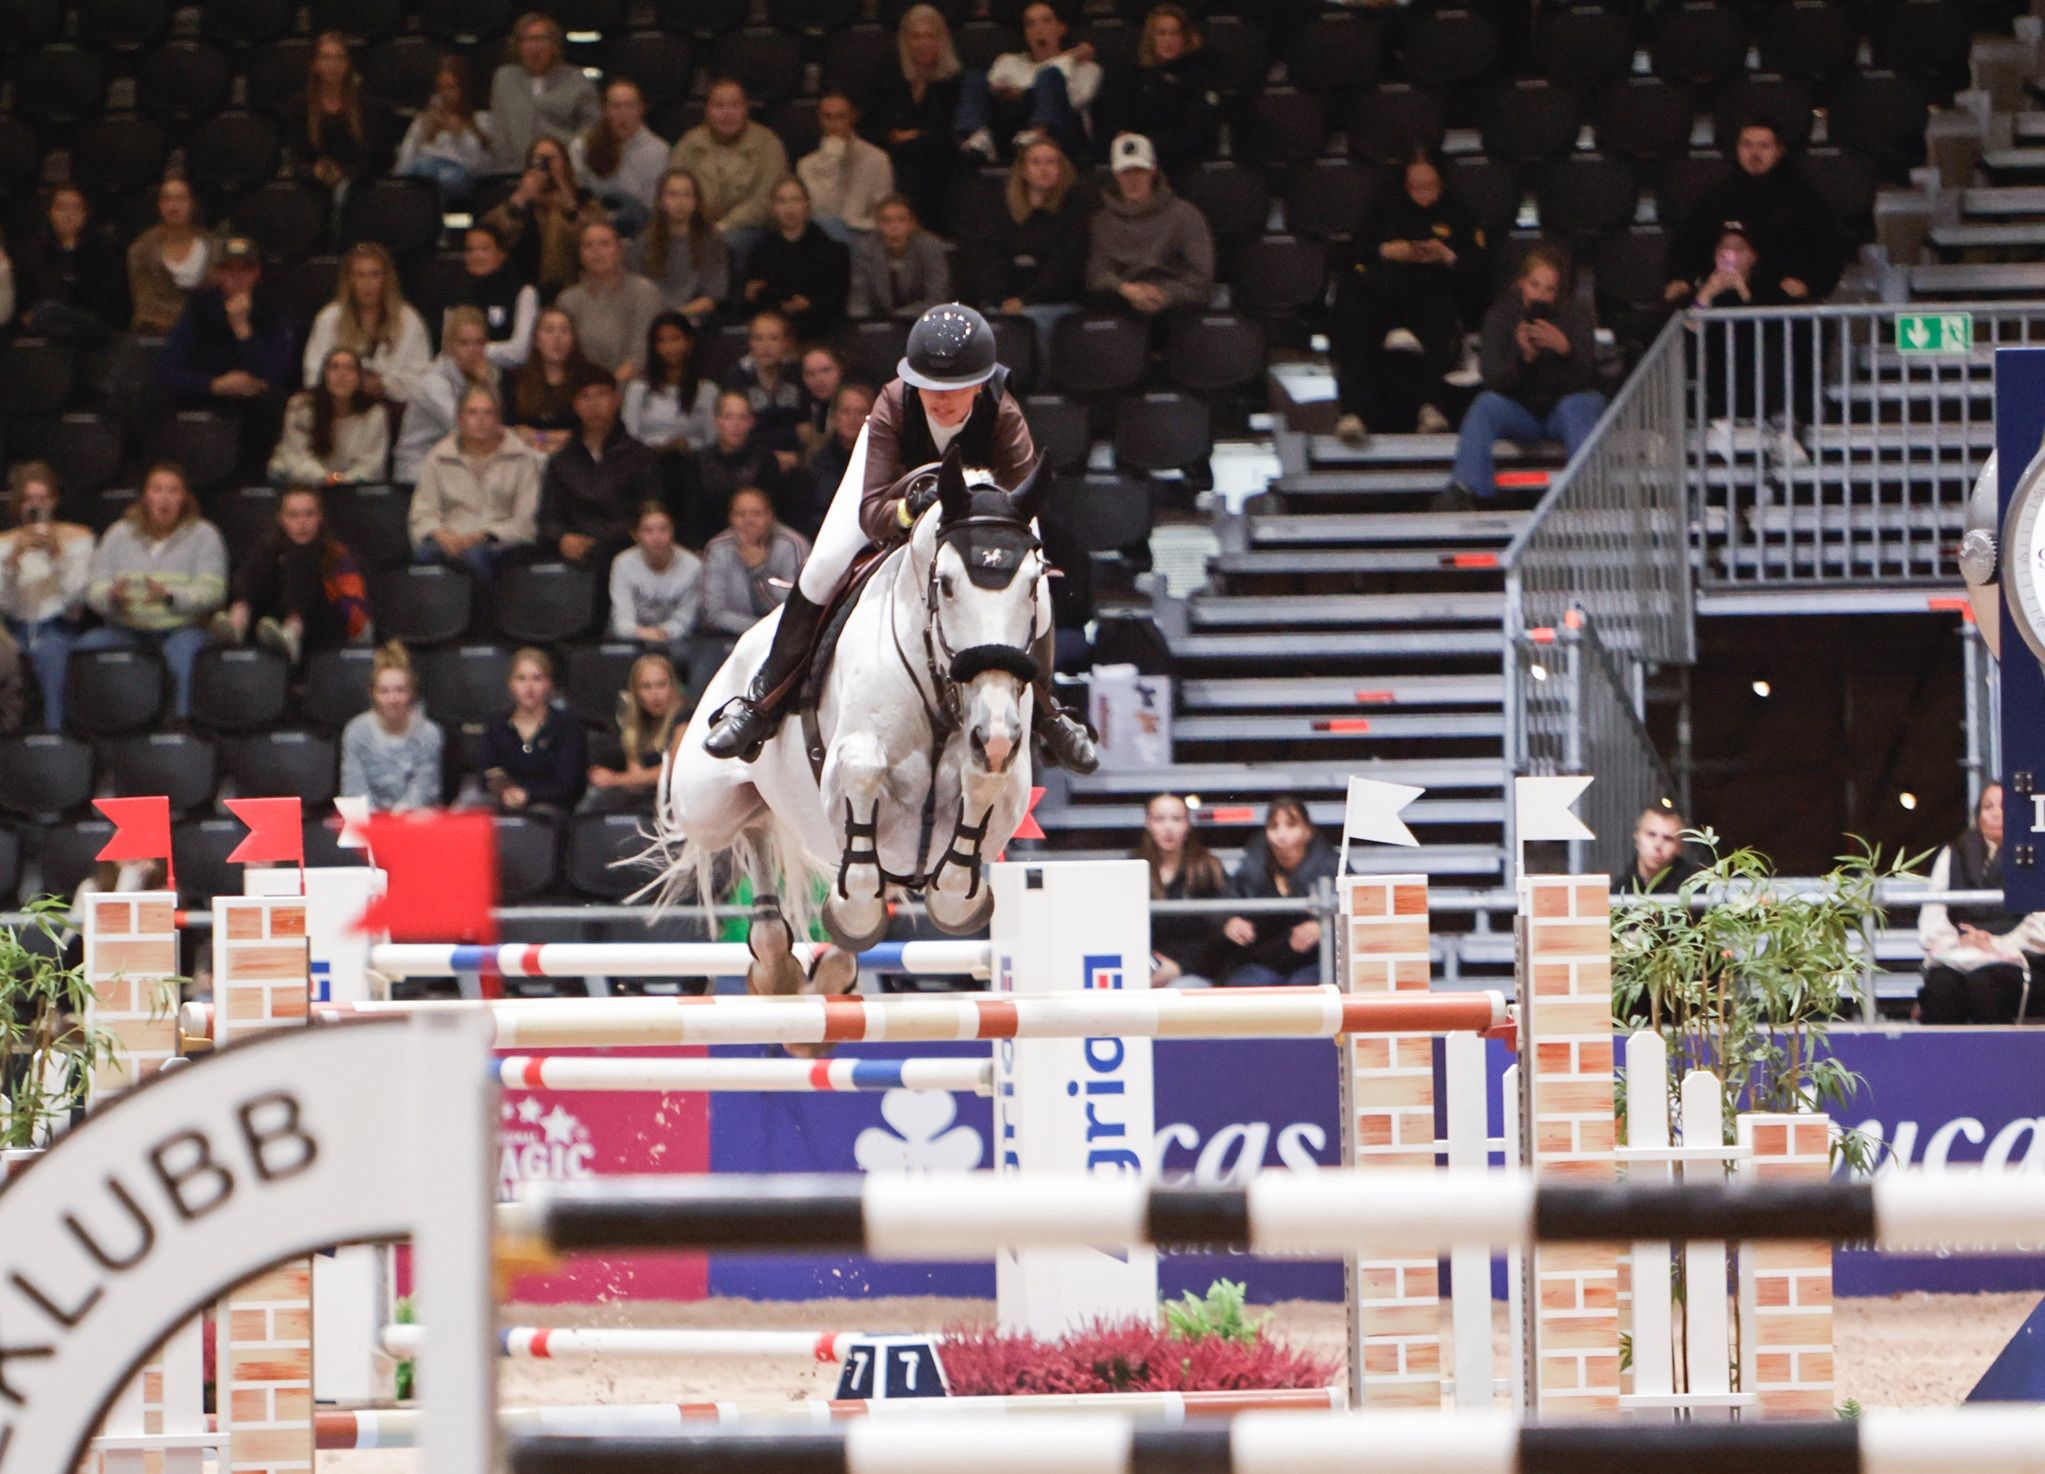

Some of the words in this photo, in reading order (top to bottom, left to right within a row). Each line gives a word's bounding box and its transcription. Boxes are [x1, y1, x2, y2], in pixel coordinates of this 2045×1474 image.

[499, 1140, 595, 1182] AGIC
[1067, 1037, 1141, 1264] gria
[1153, 1121, 1327, 1188] cas
[0, 1093, 318, 1452] KLUBB
[850, 1352, 868, 1391] 7
[898, 1351, 920, 1391] 7
